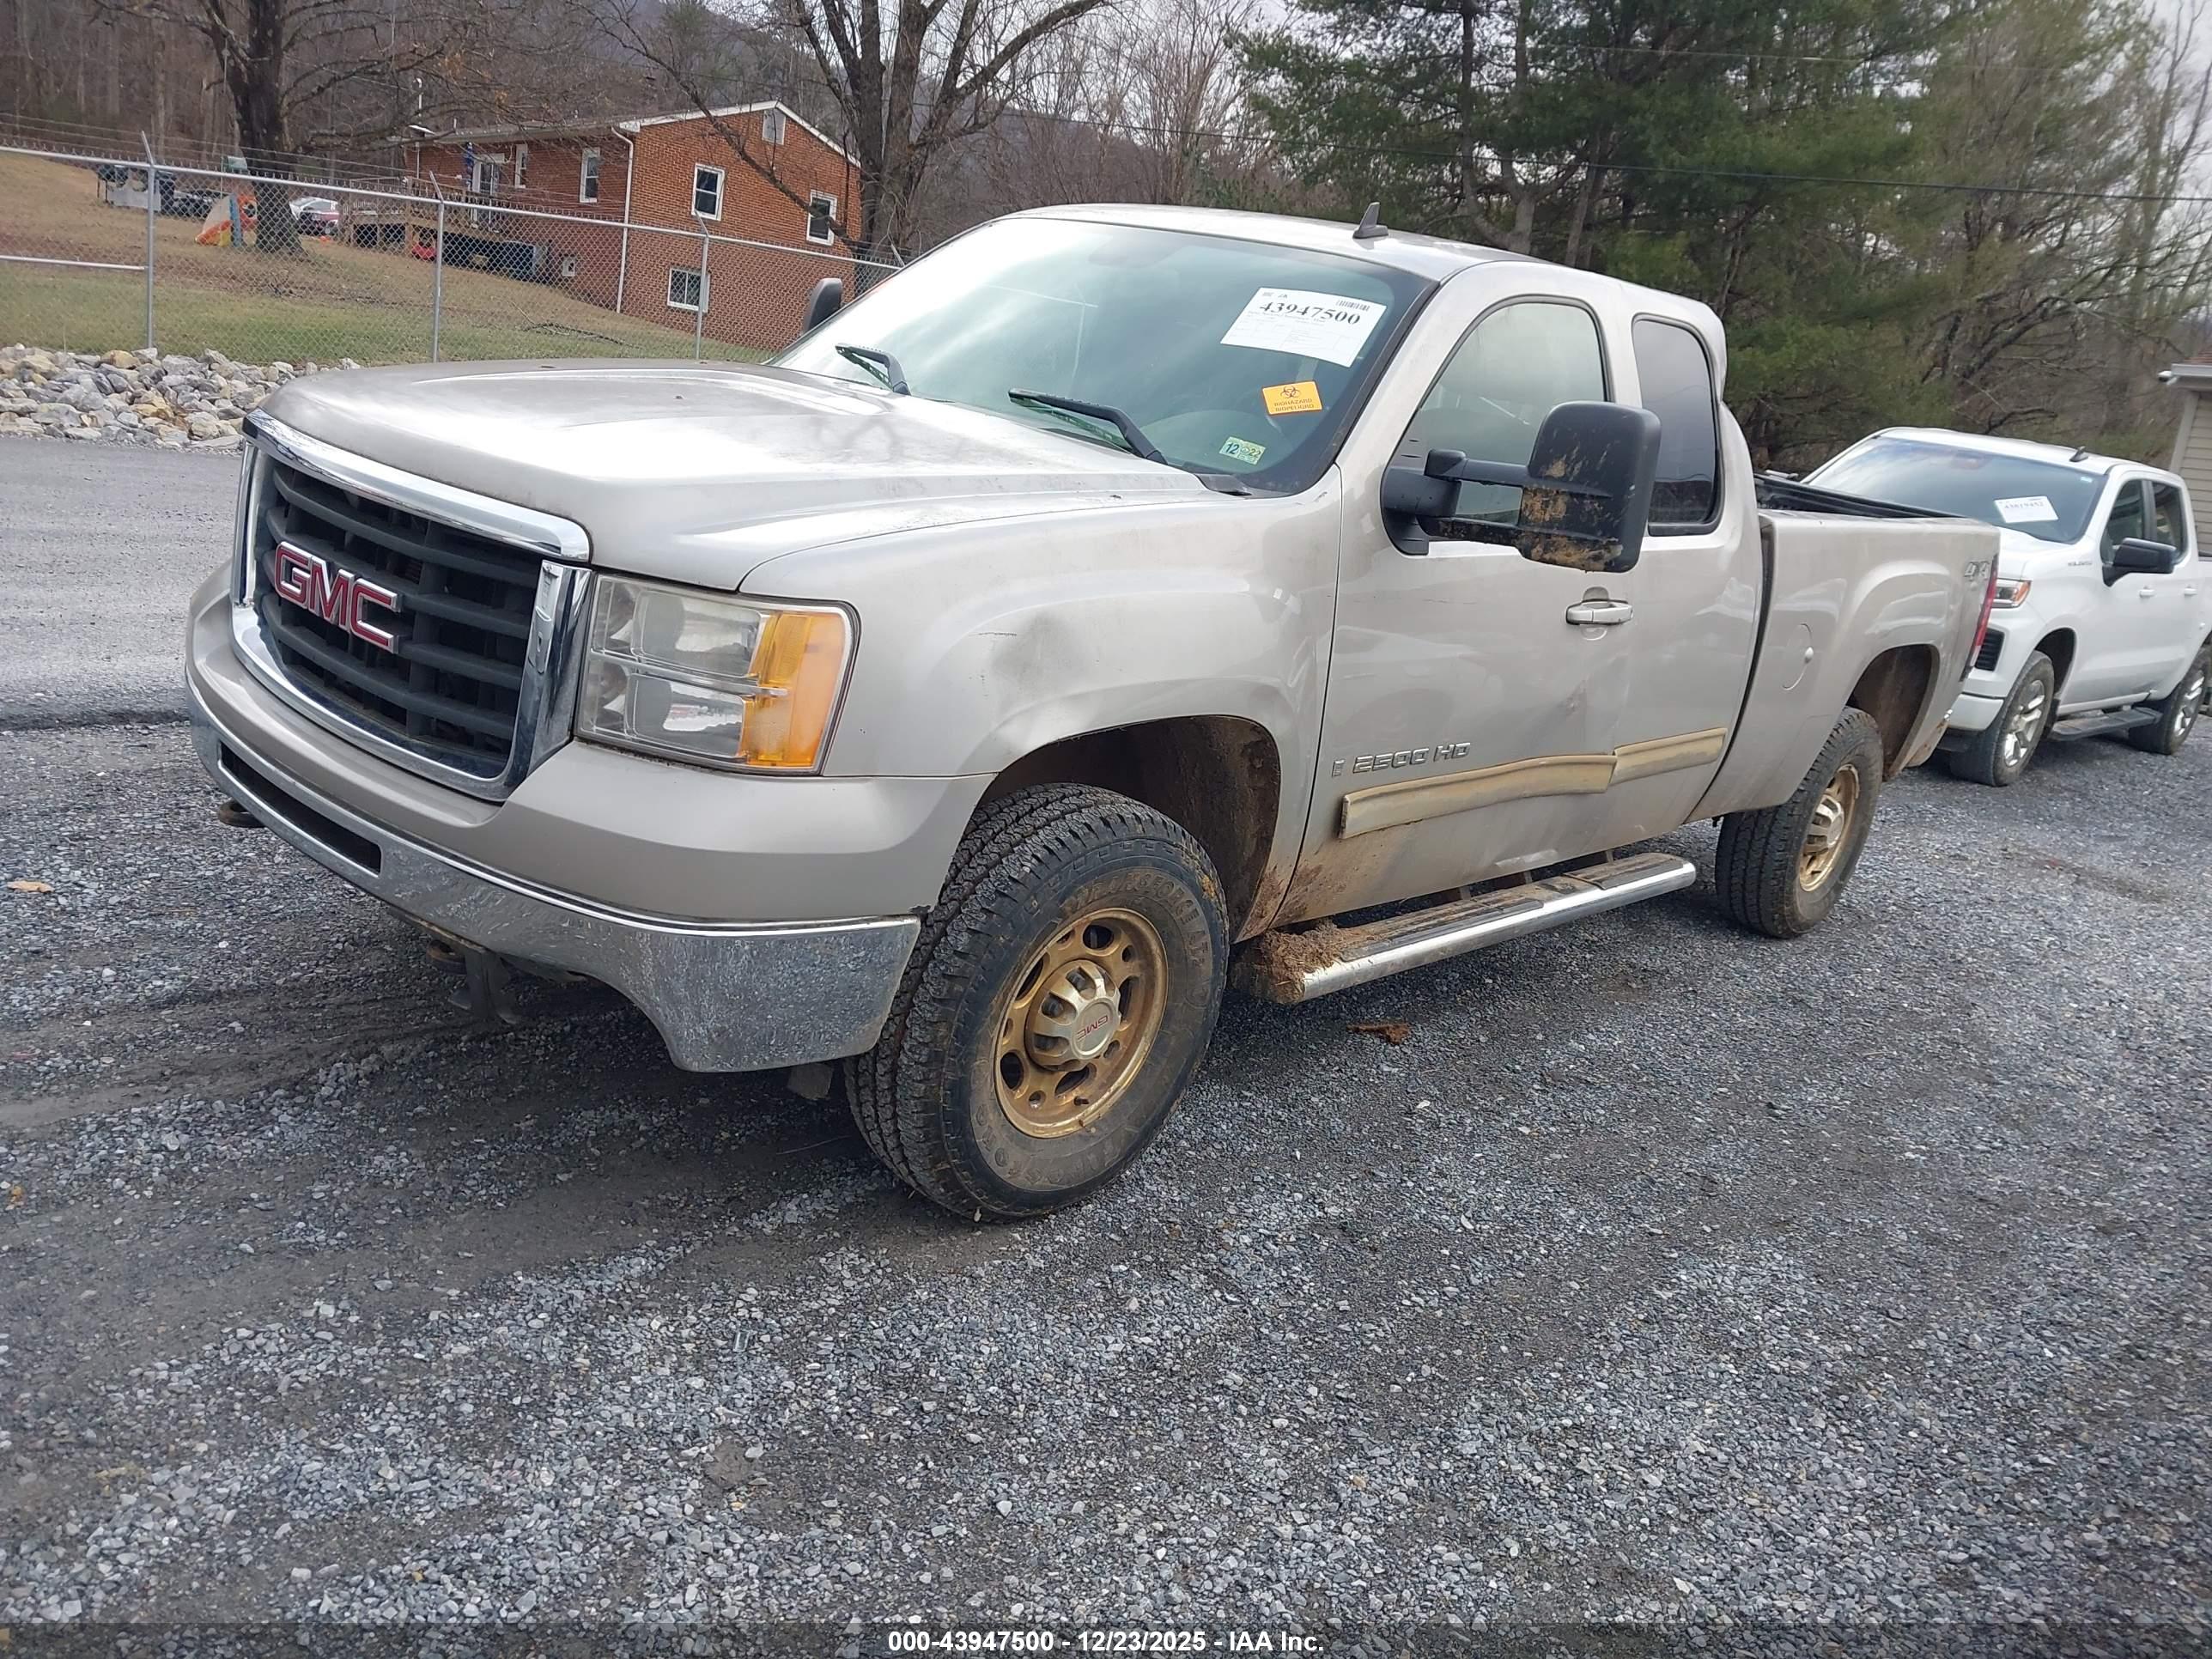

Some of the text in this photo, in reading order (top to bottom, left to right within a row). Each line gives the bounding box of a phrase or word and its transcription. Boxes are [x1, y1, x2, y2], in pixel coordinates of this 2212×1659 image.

[1259, 301, 1361, 325] 43947500
[1273, 398, 1313, 407] BIOHAZARD
[1225, 442, 1240, 455] 12
[275, 541, 403, 654] GMC
[1352, 742, 1471, 775] 2500 HD
[1075, 1014, 1109, 1042] GMC
